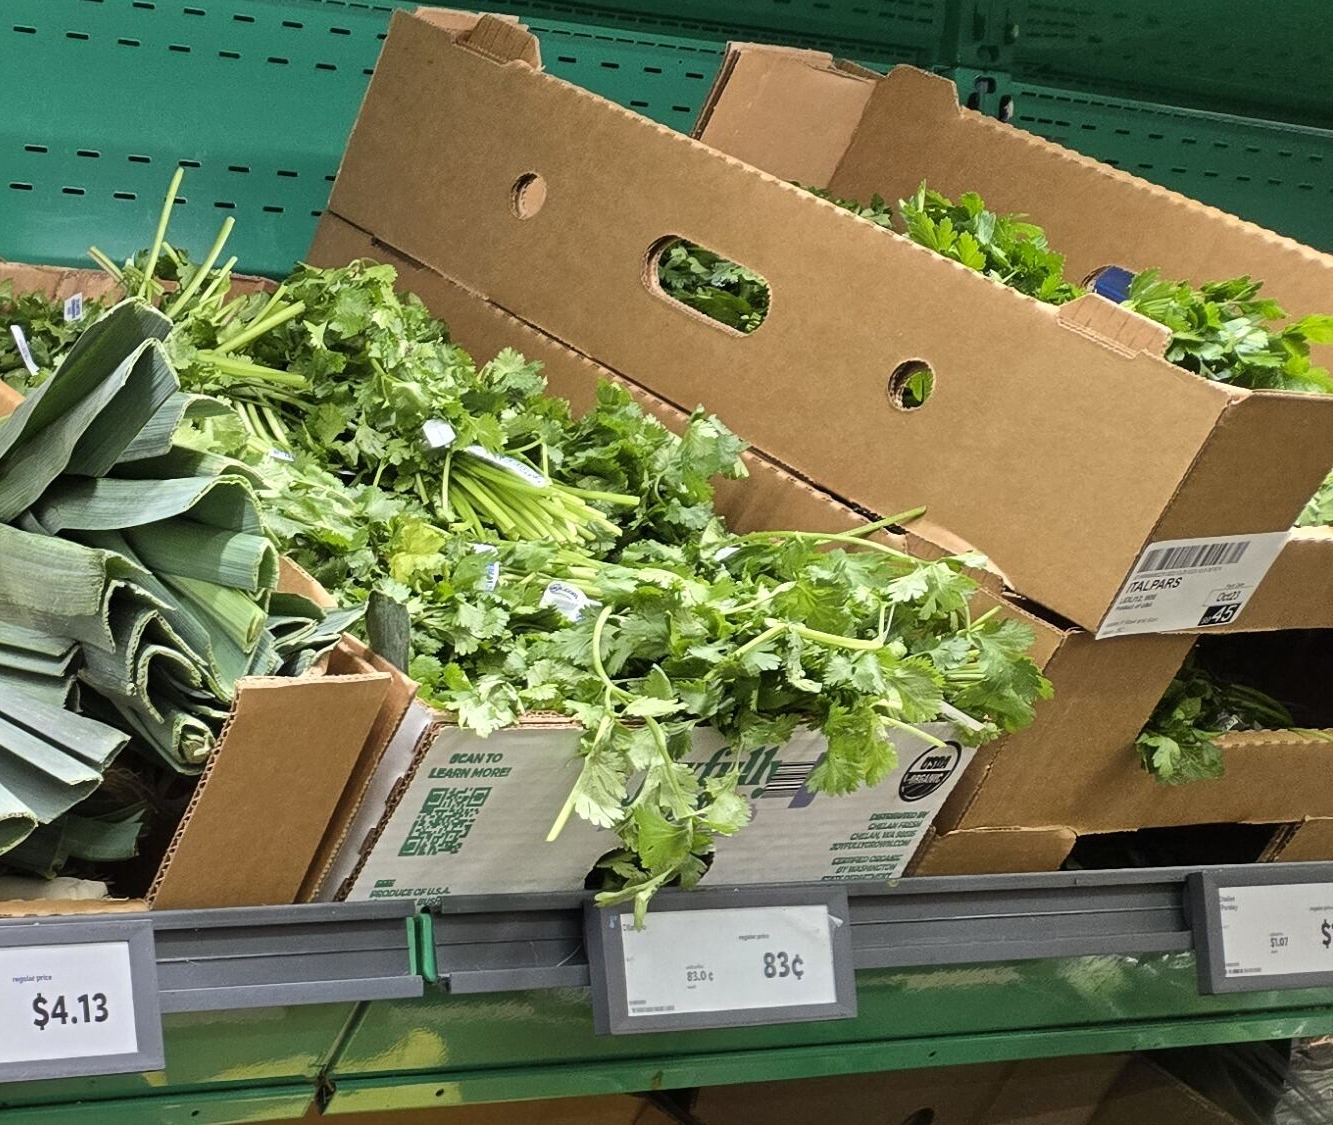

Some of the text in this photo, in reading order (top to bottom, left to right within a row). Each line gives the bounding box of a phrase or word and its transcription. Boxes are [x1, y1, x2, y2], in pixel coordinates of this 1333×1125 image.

[1126, 577, 1183, 593] ITALPARS
[1211, 604, 1238, 622] 45
[448, 753, 503, 764] SCAN TO
[428, 767, 512, 779] LEARN MORE!
[369, 889, 413, 898] PRODUCE
[414, 888, 426, 896] OF
[763, 951, 805, 980] 83¢
[35, 973, 52, 983] price
[686, 970, 707, 982] 83.0
[32, 992, 109, 1031] $4.13
